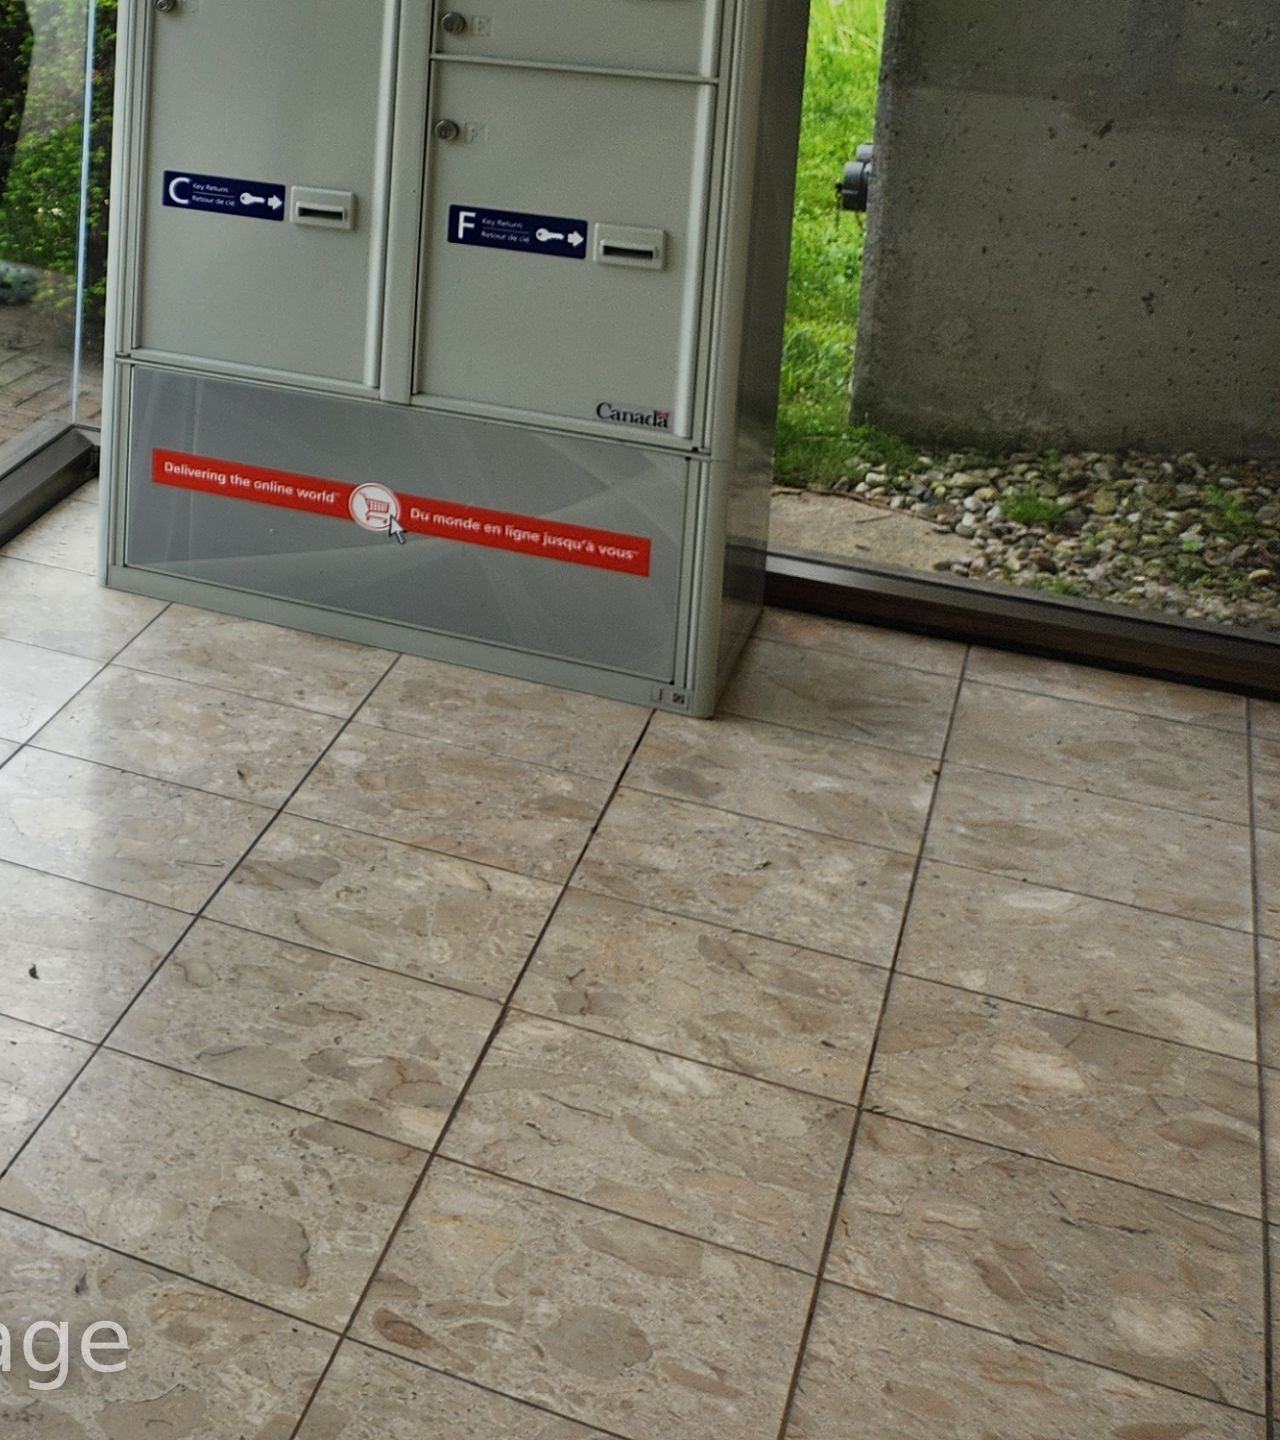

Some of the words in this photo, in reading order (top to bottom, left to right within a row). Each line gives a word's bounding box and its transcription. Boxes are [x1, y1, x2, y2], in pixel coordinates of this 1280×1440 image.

[169, 176, 189, 204] C
[458, 211, 476, 239] F
[596, 402, 668, 429] Canada
[164, 461, 226, 484] Delivering
[230, 473, 250, 488] the
[254, 480, 293, 495] online
[410, 507, 430, 521] Du
[433, 512, 480, 531] monde
[484, 523, 501, 535] en
[505, 525, 540, 542] ligne
